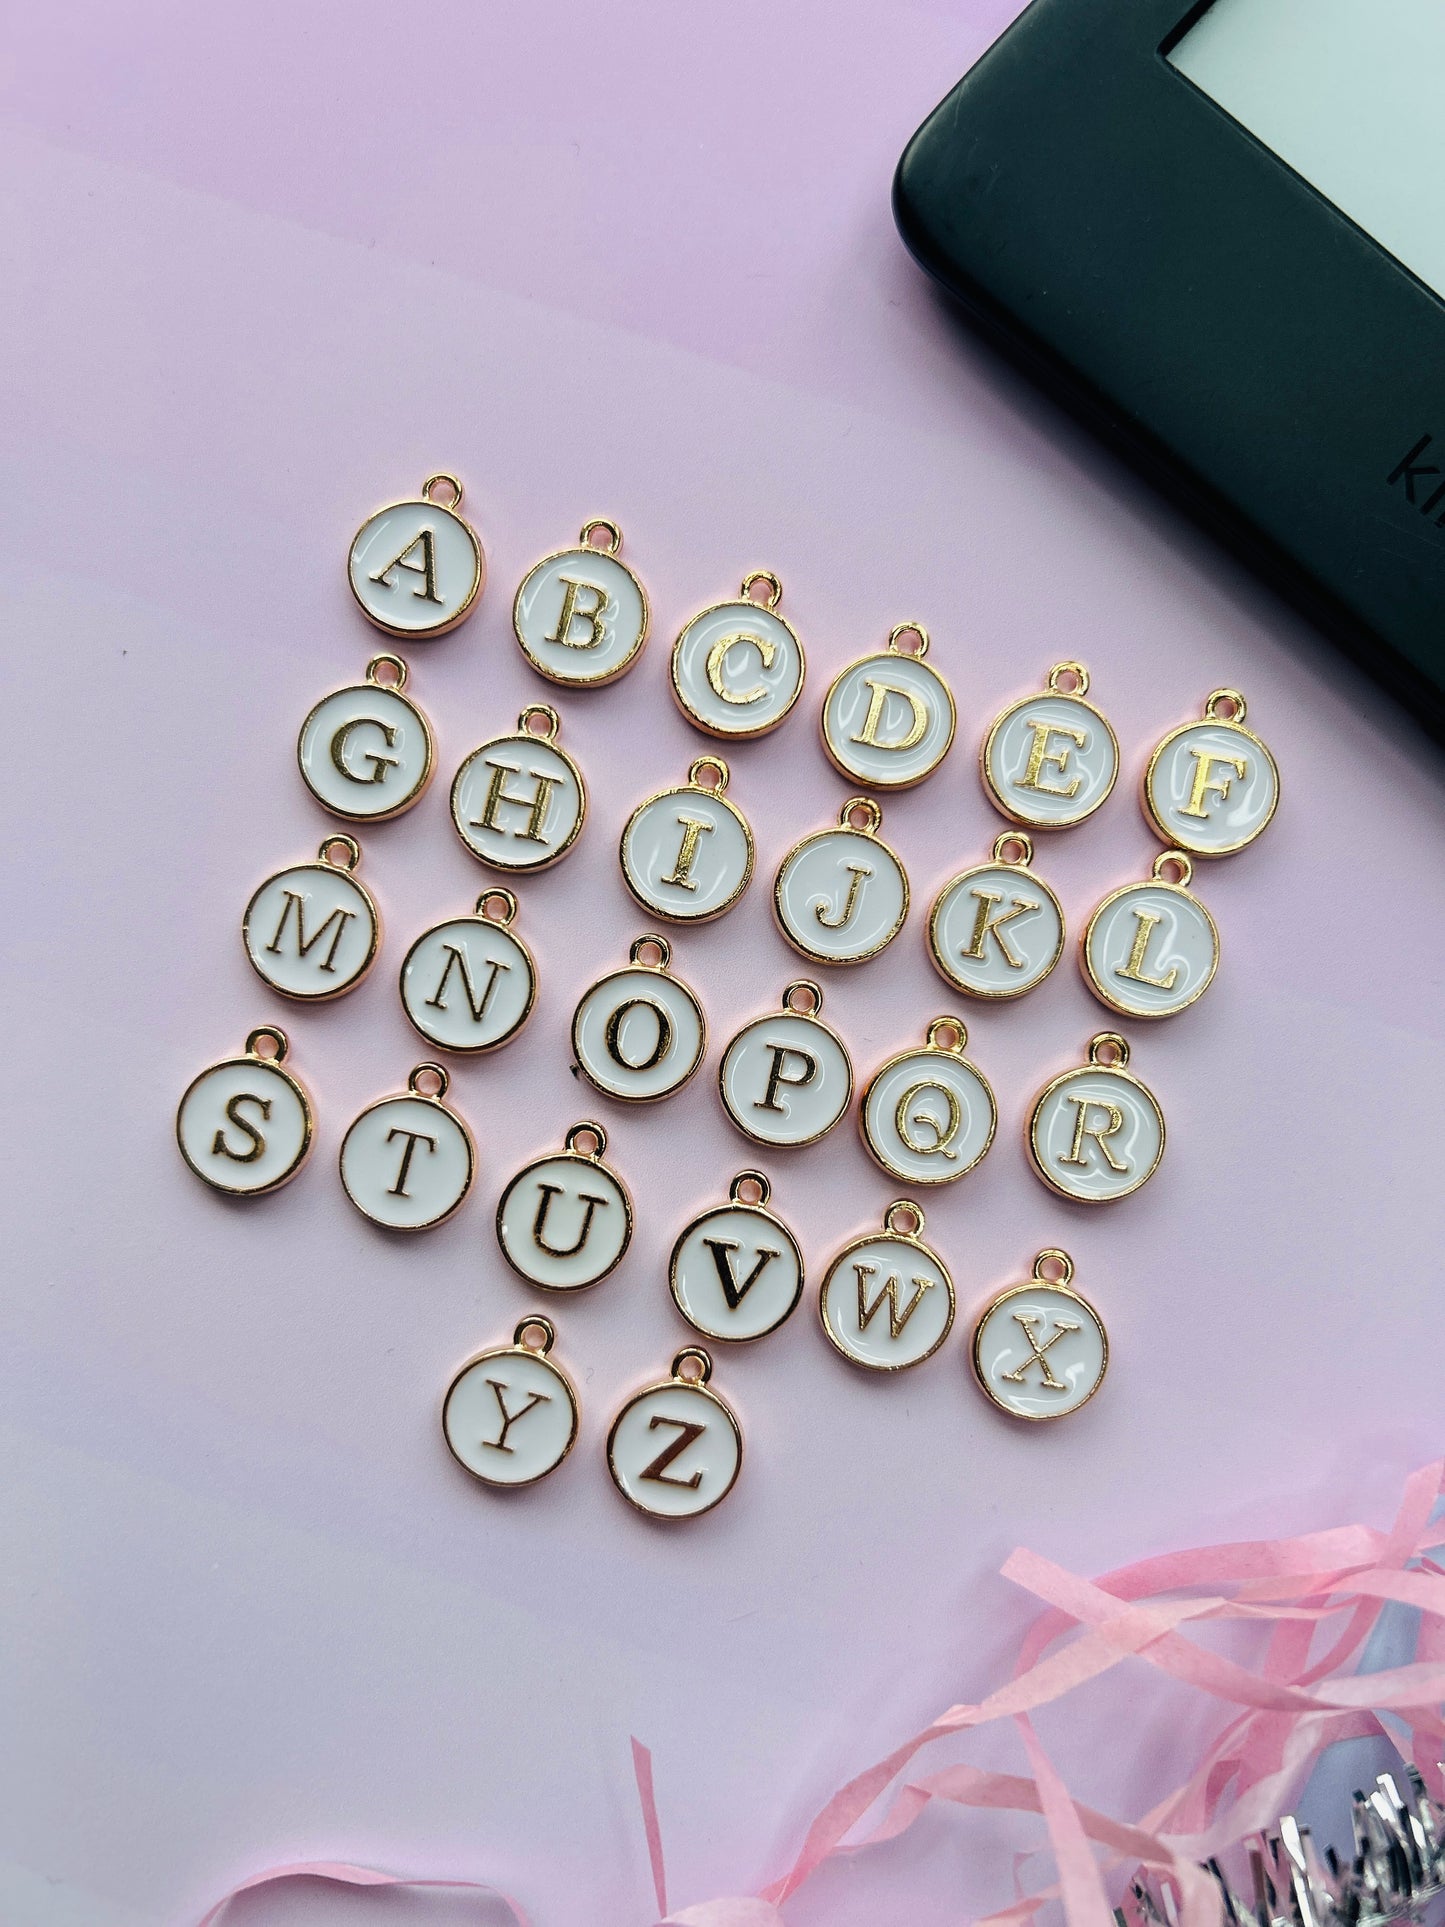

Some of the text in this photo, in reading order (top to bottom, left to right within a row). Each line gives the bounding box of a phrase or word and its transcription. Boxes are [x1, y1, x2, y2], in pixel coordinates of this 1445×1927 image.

[369, 529, 444, 604] A
[545, 576, 608, 648] B
[706, 634, 775, 704] C
[850, 679, 929, 749] D
[331, 719, 399, 783] G
[1014, 721, 1086, 797] E
[1178, 750, 1246, 818] F
[471, 761, 565, 845] H
[661, 818, 713, 890] I
[267, 890, 356, 971] M
[816, 865, 871, 927] J
[960, 890, 1039, 967] K
[426, 944, 511, 1022] N
[1115, 909, 1177, 988] L
[605, 998, 671, 1071] O
[754, 1043, 817, 1111] P
[213, 1093, 272, 1162] S
[895, 1081, 960, 1159] Q
[1059, 1096, 1127, 1170] R
[387, 1127, 438, 1197] T
[535, 1184, 609, 1256] U
[703, 1238, 781, 1309] V
[853, 1264, 935, 1337] W
[1002, 1313, 1079, 1388] X
[482, 1379, 551, 1453] Y
[640, 1415, 705, 1488] Z
